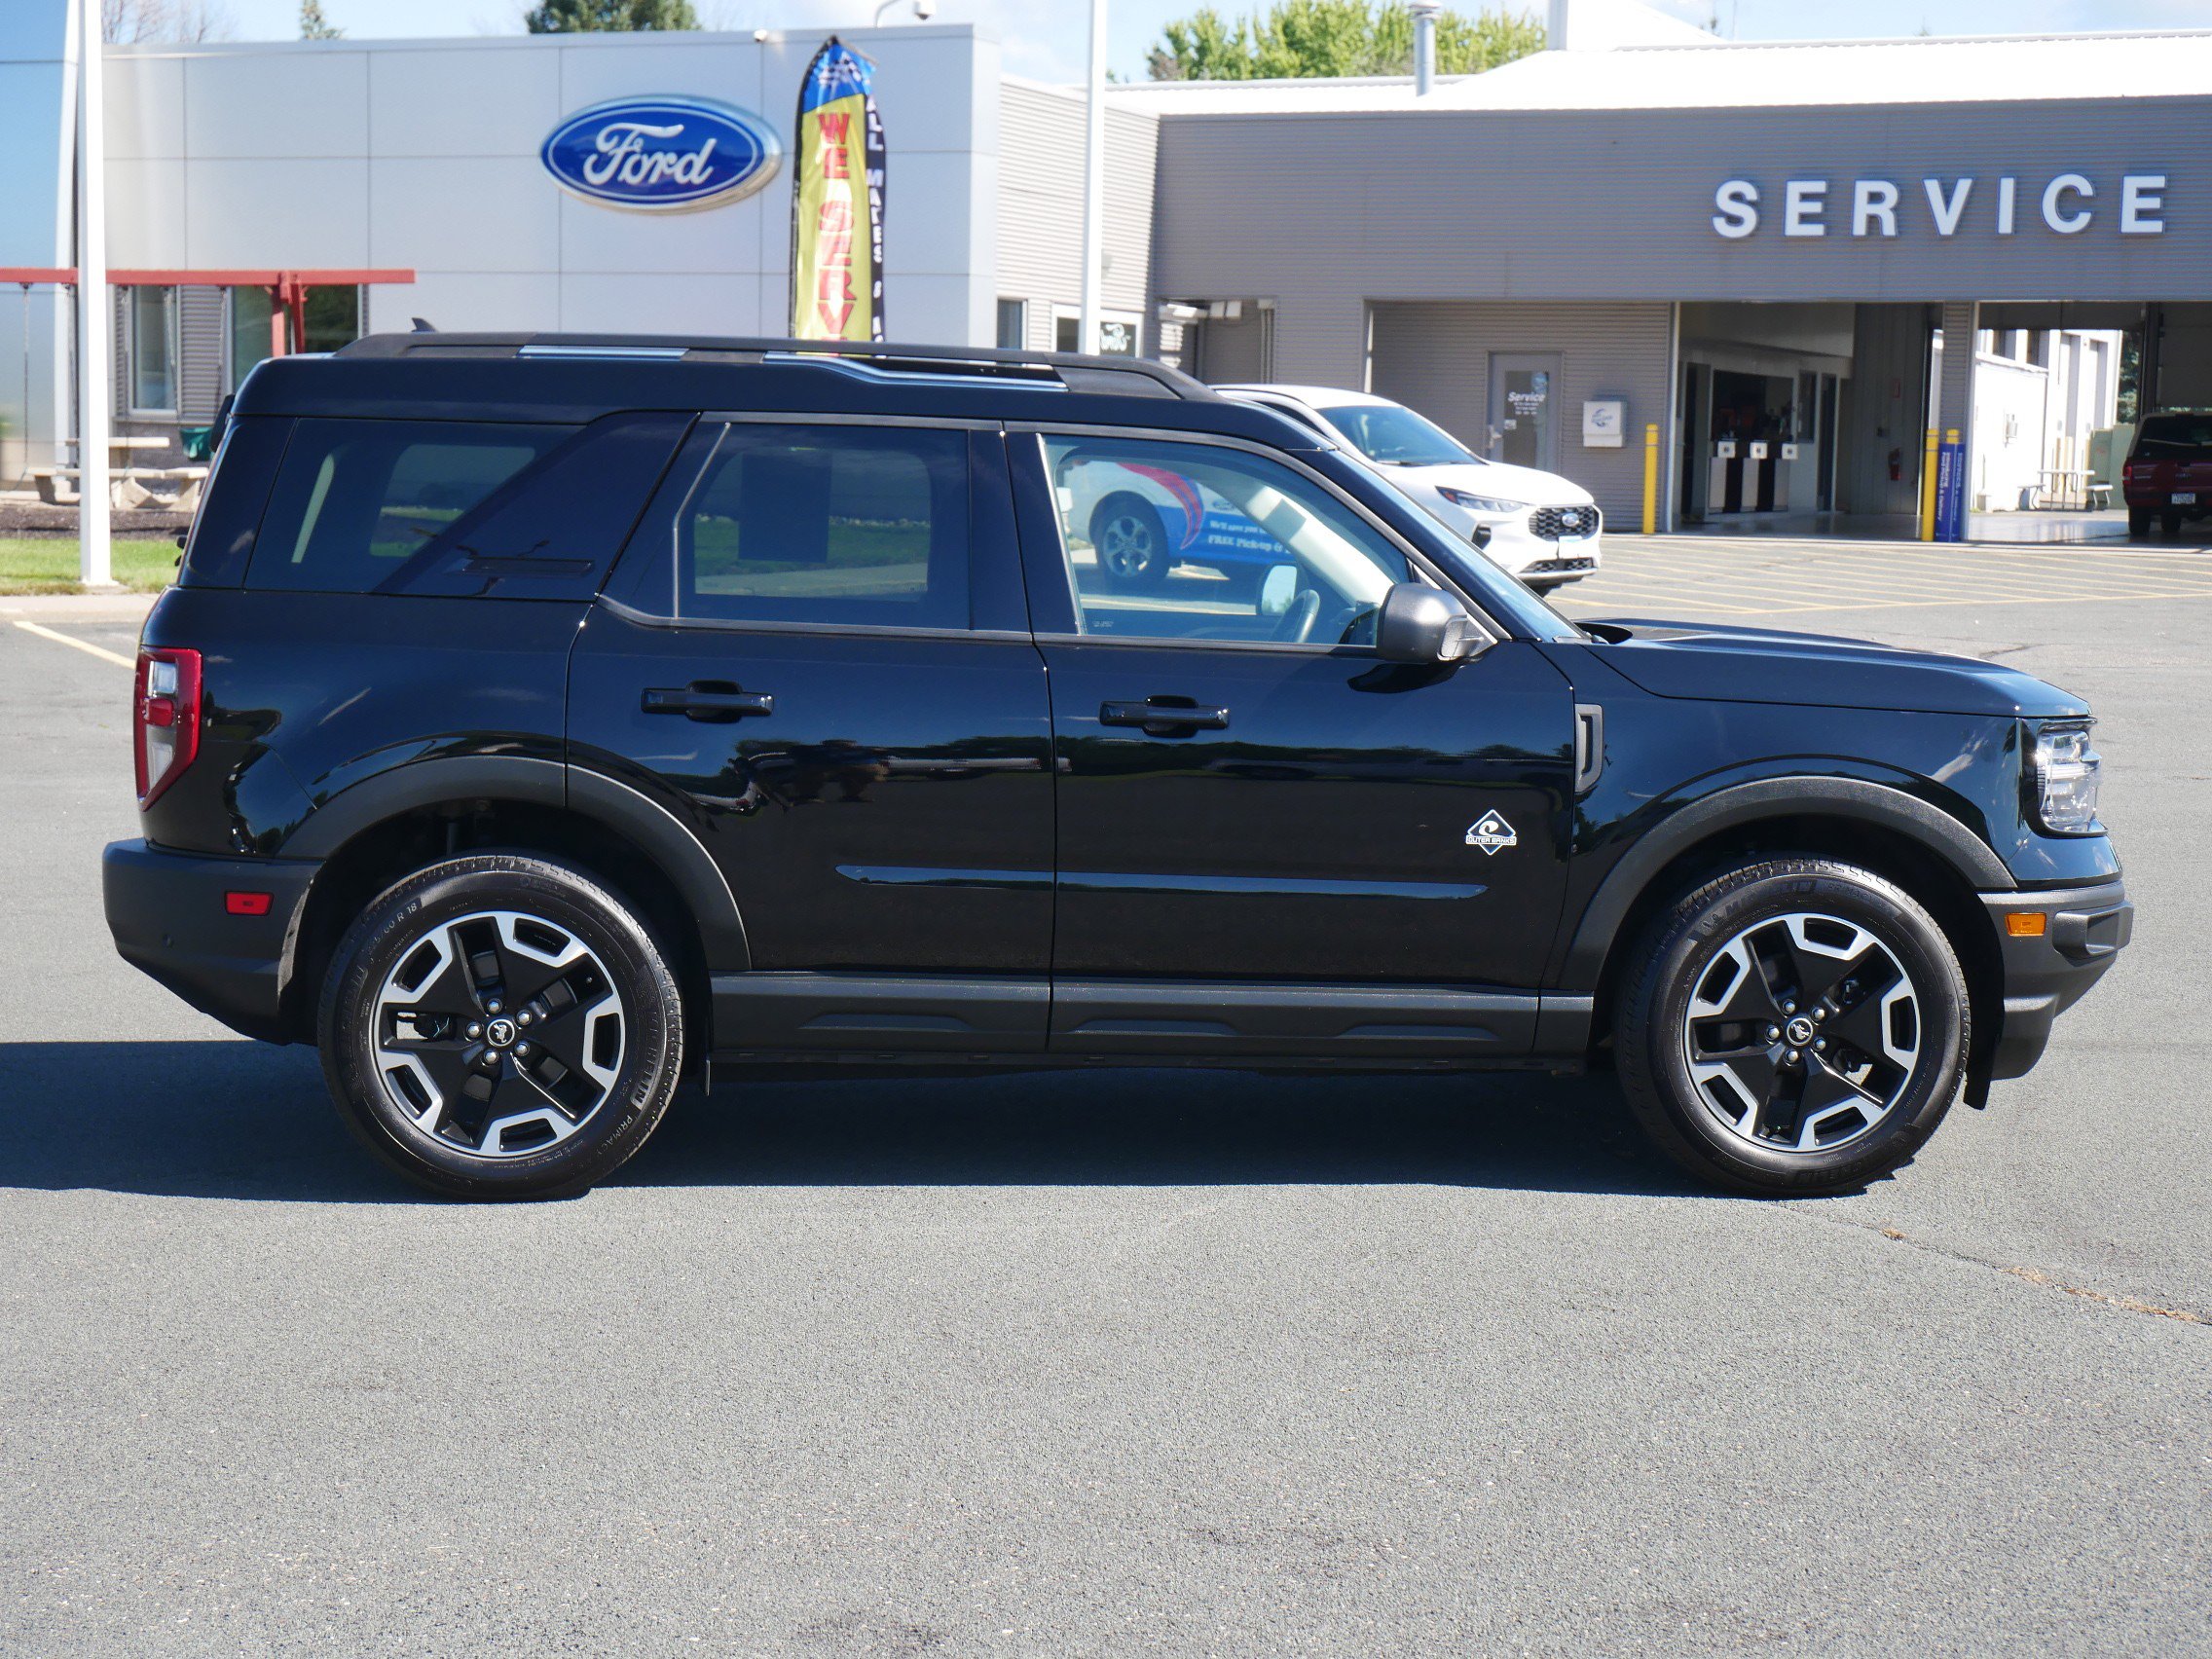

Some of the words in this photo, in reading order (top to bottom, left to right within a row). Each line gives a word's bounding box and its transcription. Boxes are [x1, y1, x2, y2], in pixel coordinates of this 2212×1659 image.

[583, 123, 718, 186] Ford
[817, 113, 850, 179] WE
[866, 95, 884, 151] ALL
[866, 168, 884, 263] MAKES
[1712, 173, 2166, 239] SERVICE
[817, 201, 857, 342] SERV
[1507, 391, 1546, 402] Service
[1208, 535, 1235, 545] FREE
[406, 903, 418, 914] 18
